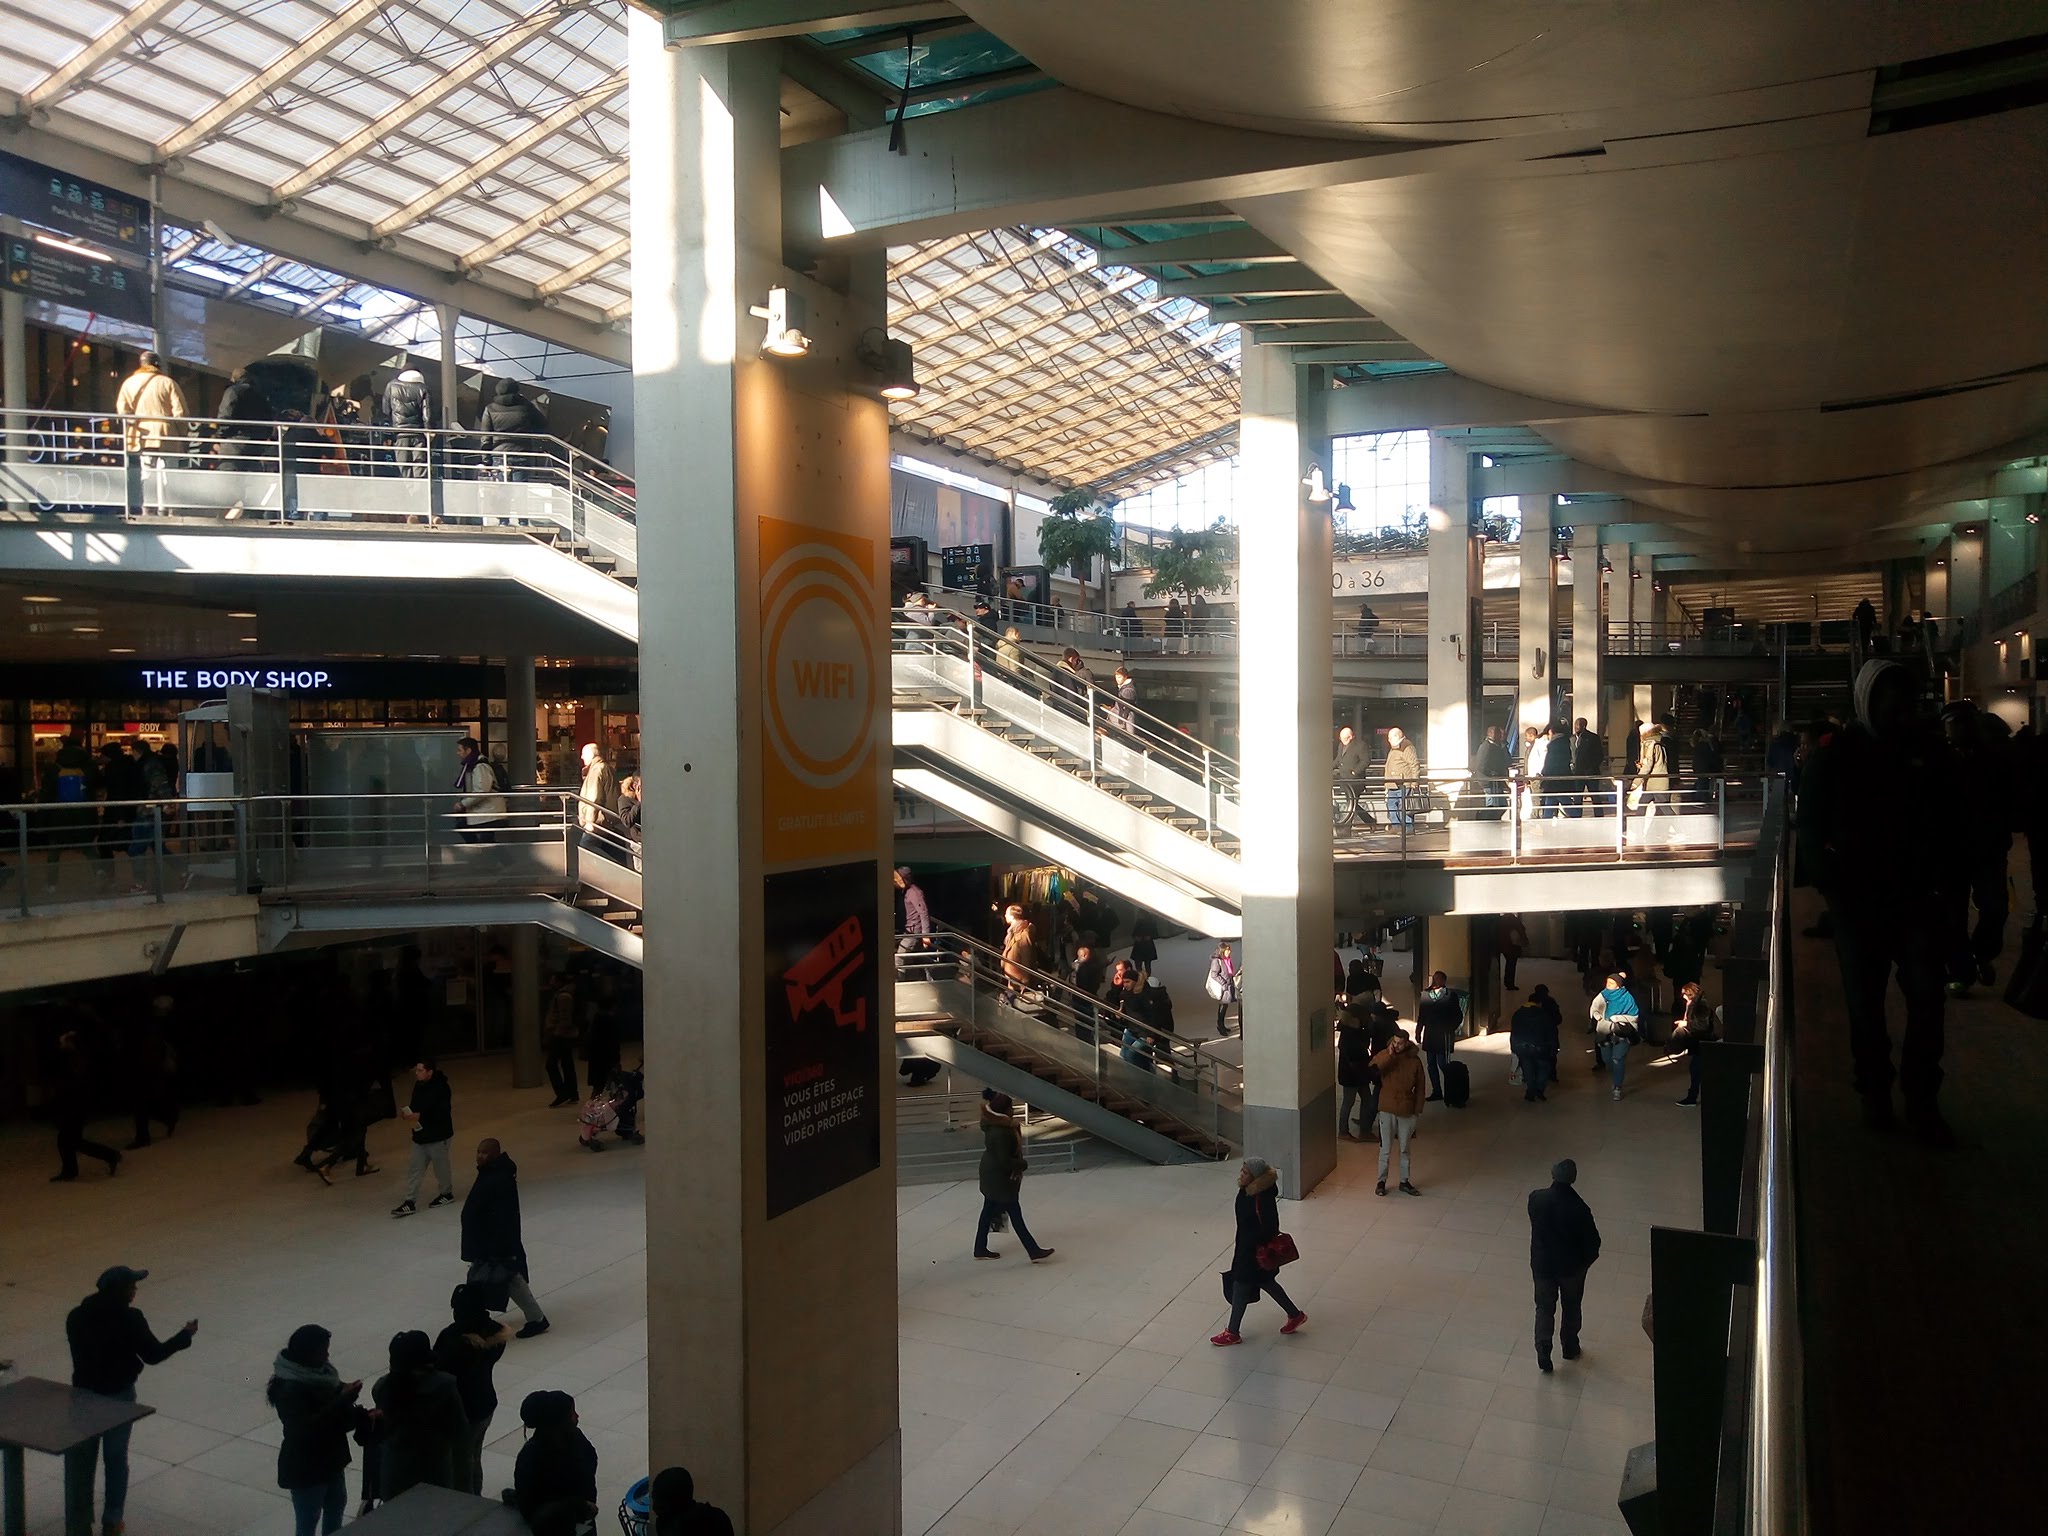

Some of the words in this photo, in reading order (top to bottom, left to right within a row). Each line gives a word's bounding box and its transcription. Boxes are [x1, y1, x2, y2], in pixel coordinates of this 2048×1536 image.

[1348, 576, 1356, 589] à
[1361, 569, 1385, 588] 36
[141, 670, 188, 689] THE
[197, 670, 260, 689] BODY
[265, 670, 333, 689] SHOP.
[792, 659, 856, 699] WIFI
[139, 722, 161, 732] BODY
[778, 815, 825, 831] GRATUIT
[784, 1087, 811, 1108] VOUS
[813, 1078, 835, 1098] ÊTES
[784, 1106, 812, 1128] DANS
[814, 1100, 828, 1116] UN
[830, 1085, 864, 1109] ESPACE
[784, 1123, 815, 1146] VIDÉO
